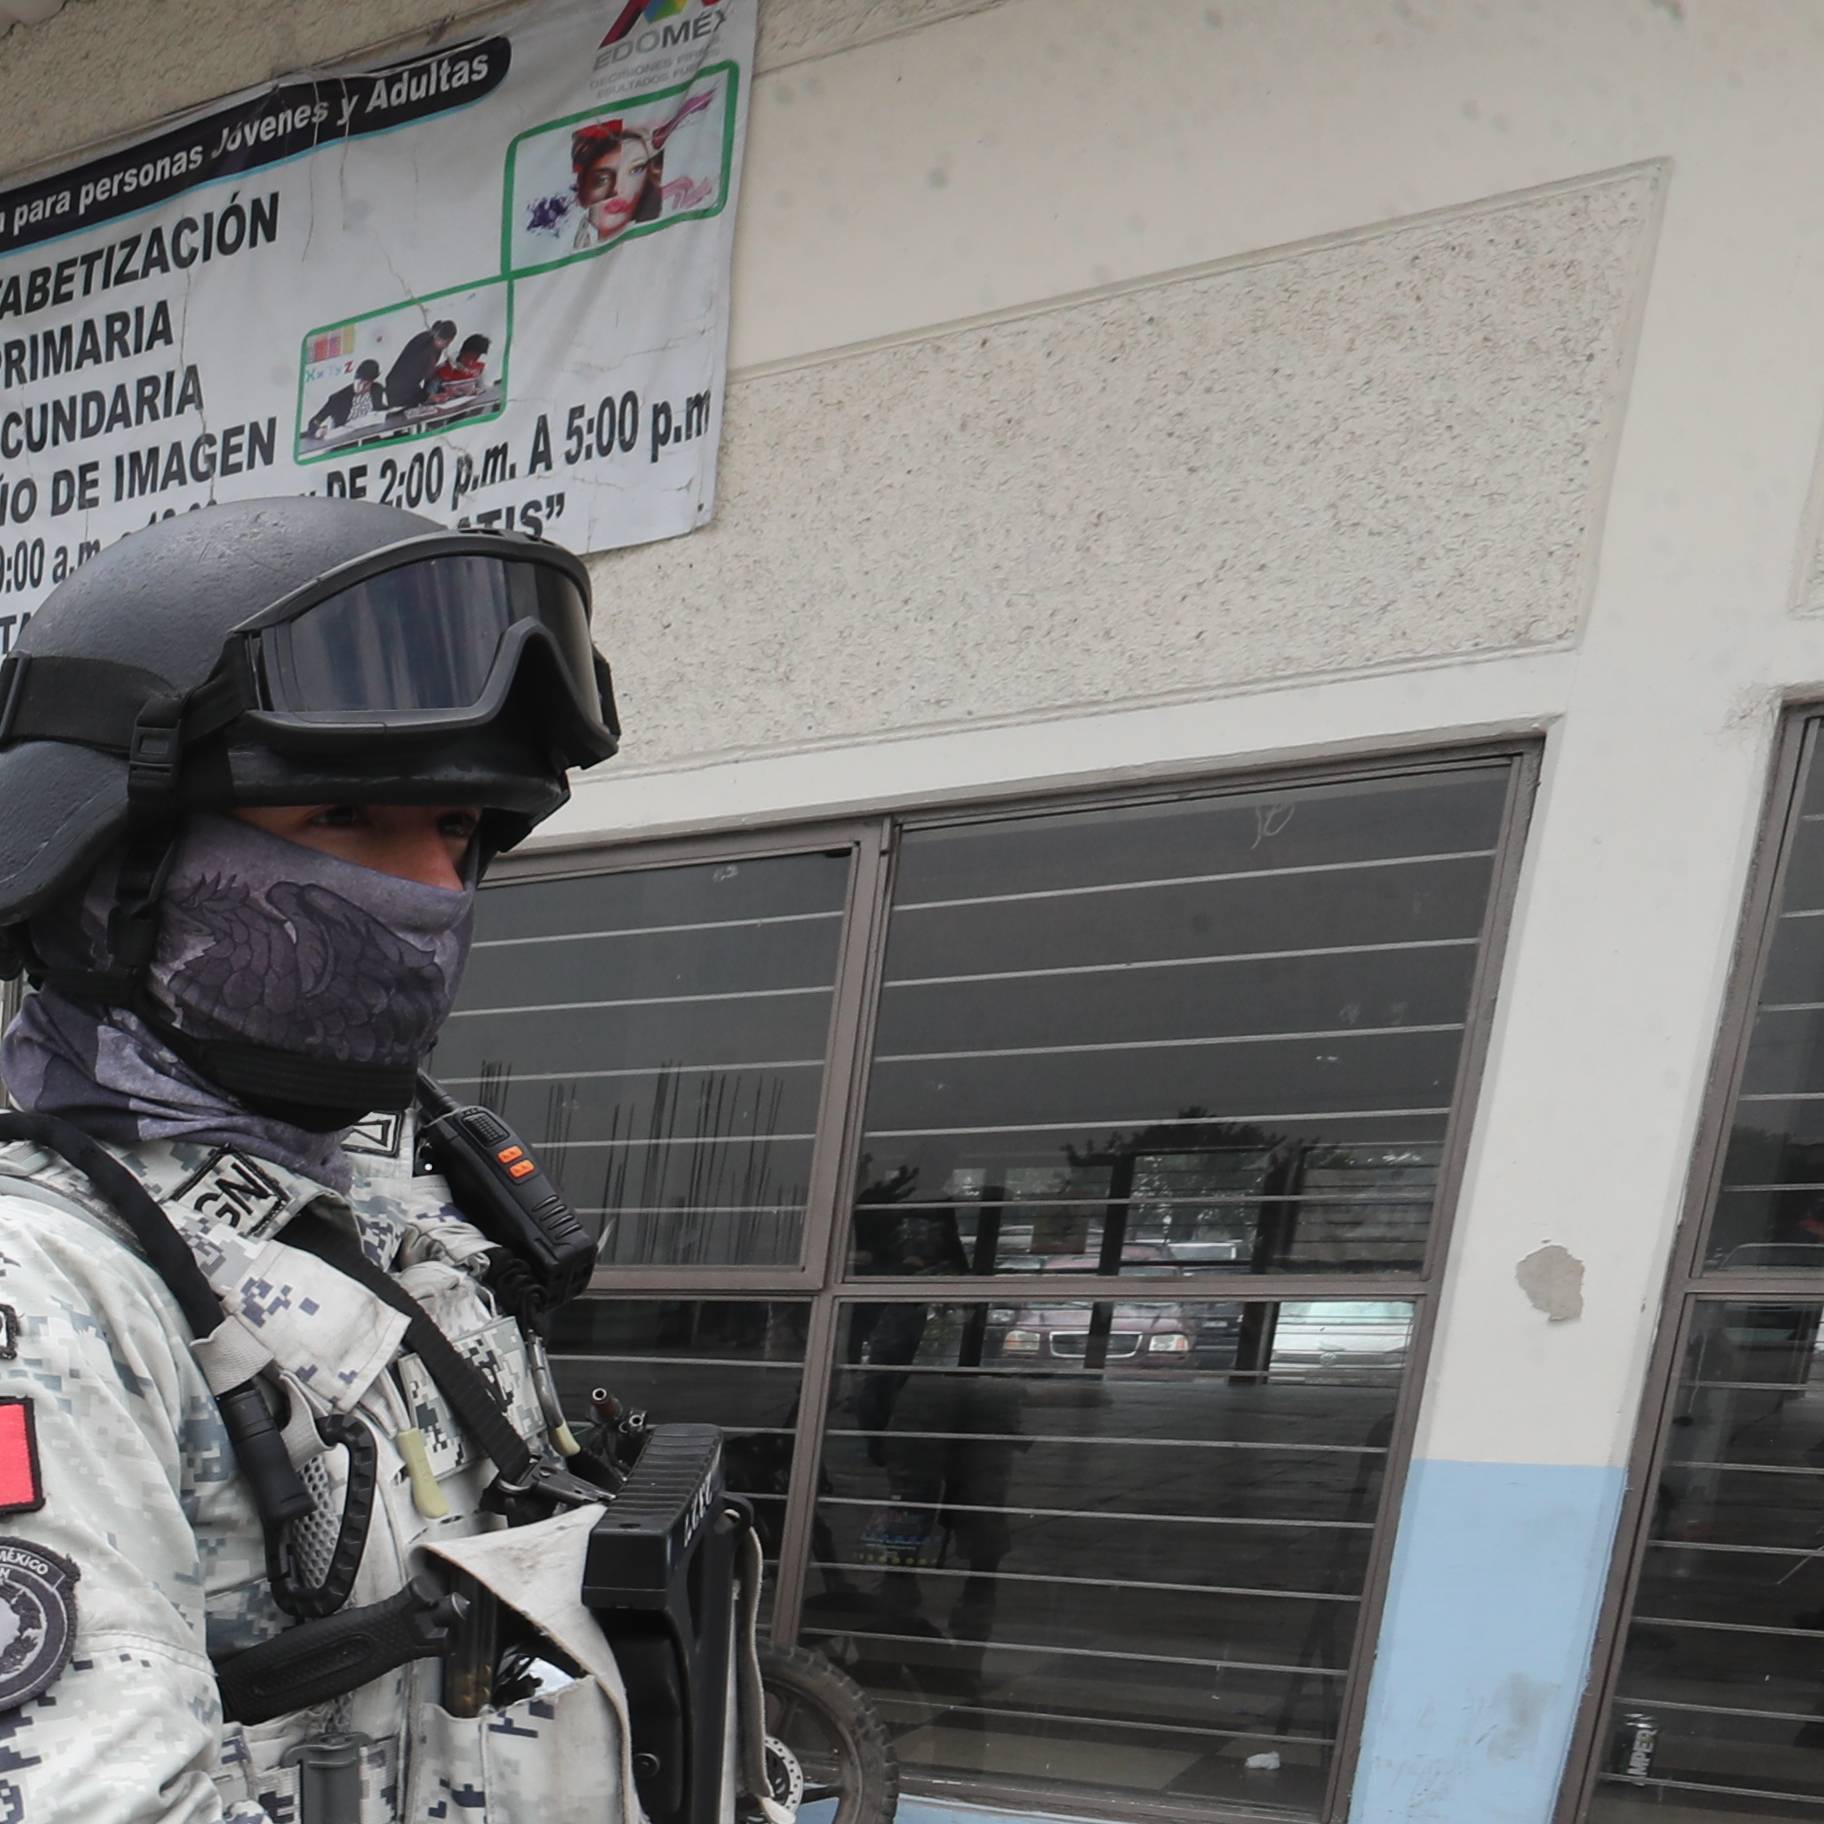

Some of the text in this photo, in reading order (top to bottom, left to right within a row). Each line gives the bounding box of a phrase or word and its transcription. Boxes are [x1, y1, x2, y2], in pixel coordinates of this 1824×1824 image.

[13, 189, 72, 237] para
[79, 142, 204, 215] personas
[211, 100, 329, 160] Jóvenes
[335, 94, 358, 126] y
[364, 52, 490, 114] Adultas
[51, 461, 100, 518] DE
[114, 416, 277, 503] IMAGEN
[379, 446, 445, 508] 2:00
[451, 441, 517, 512] p.m.
[528, 413, 553, 475] A
[564, 390, 639, 466] 5:00
[194, 1162, 273, 1229] GN
